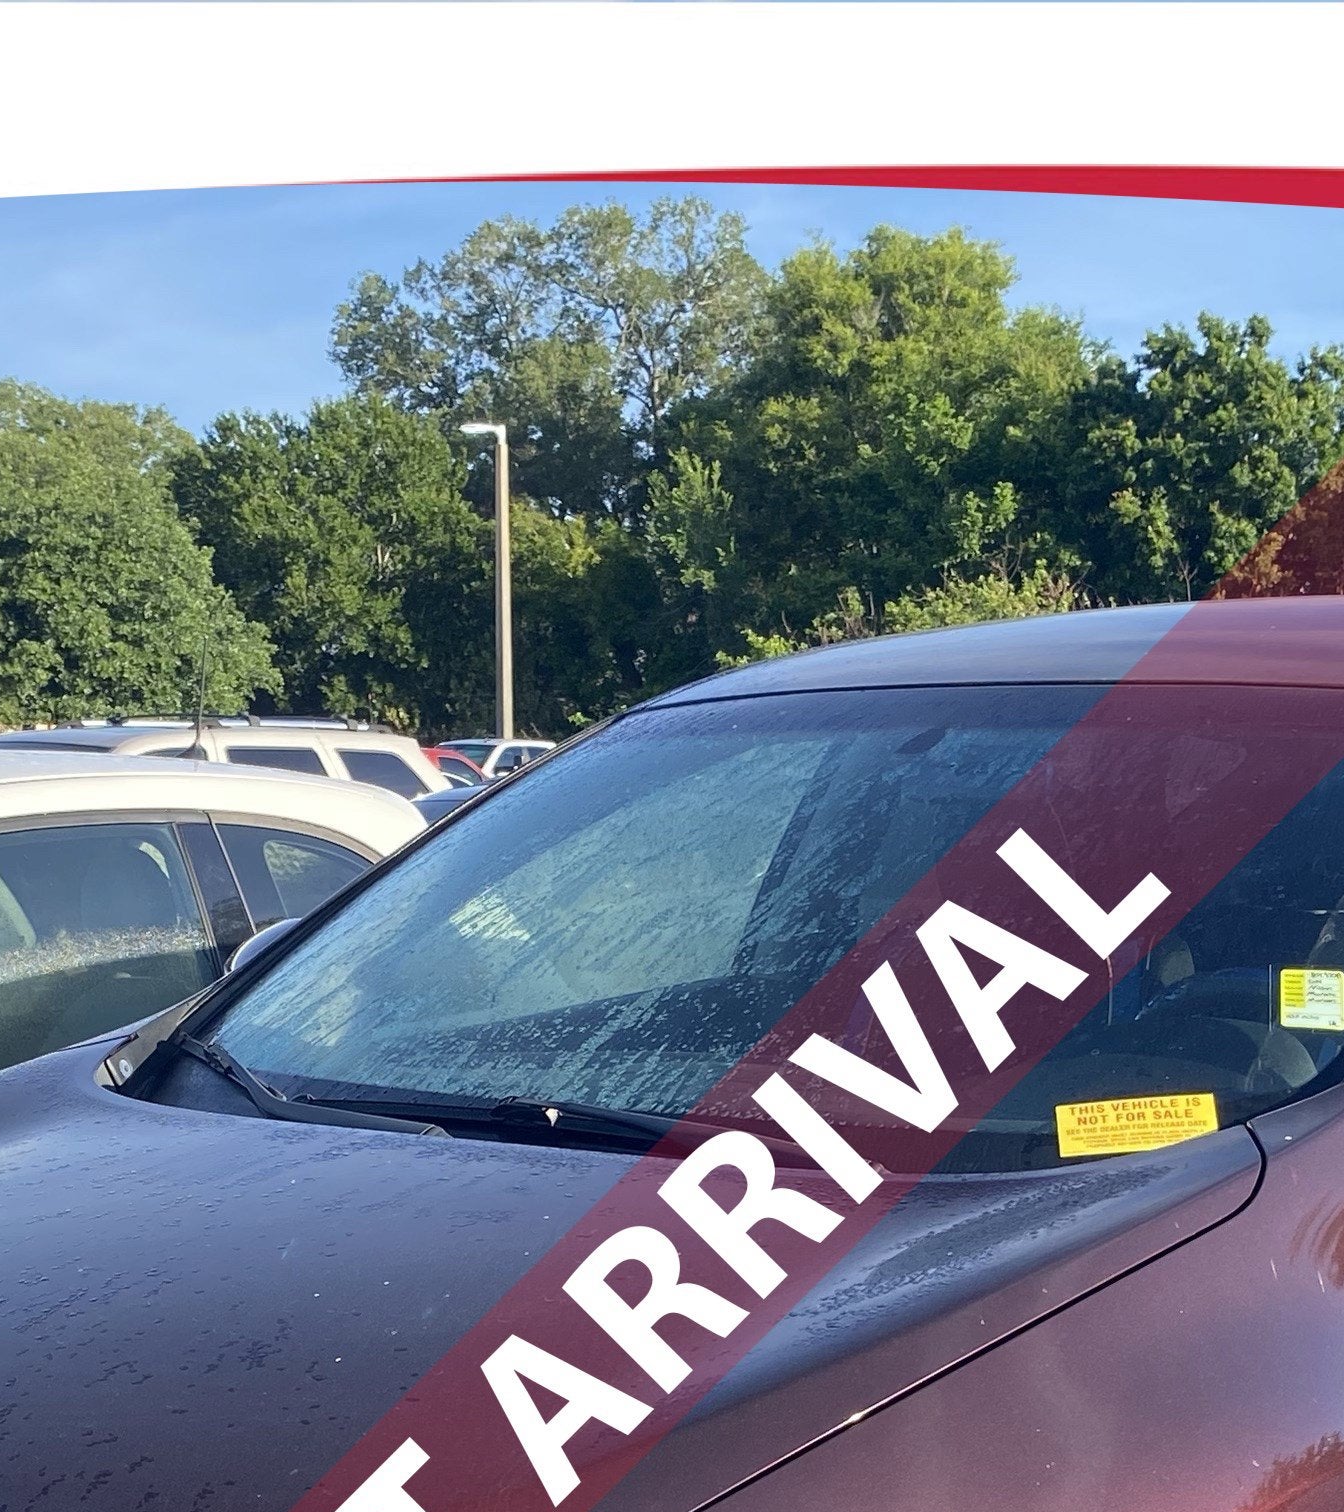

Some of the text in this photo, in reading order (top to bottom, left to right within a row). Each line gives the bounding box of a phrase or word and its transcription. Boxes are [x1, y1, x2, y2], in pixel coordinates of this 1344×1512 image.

[1069, 1097, 1202, 1116] THIS VEHICLE IS
[1077, 1108, 1194, 1126] NOT FOR SALE
